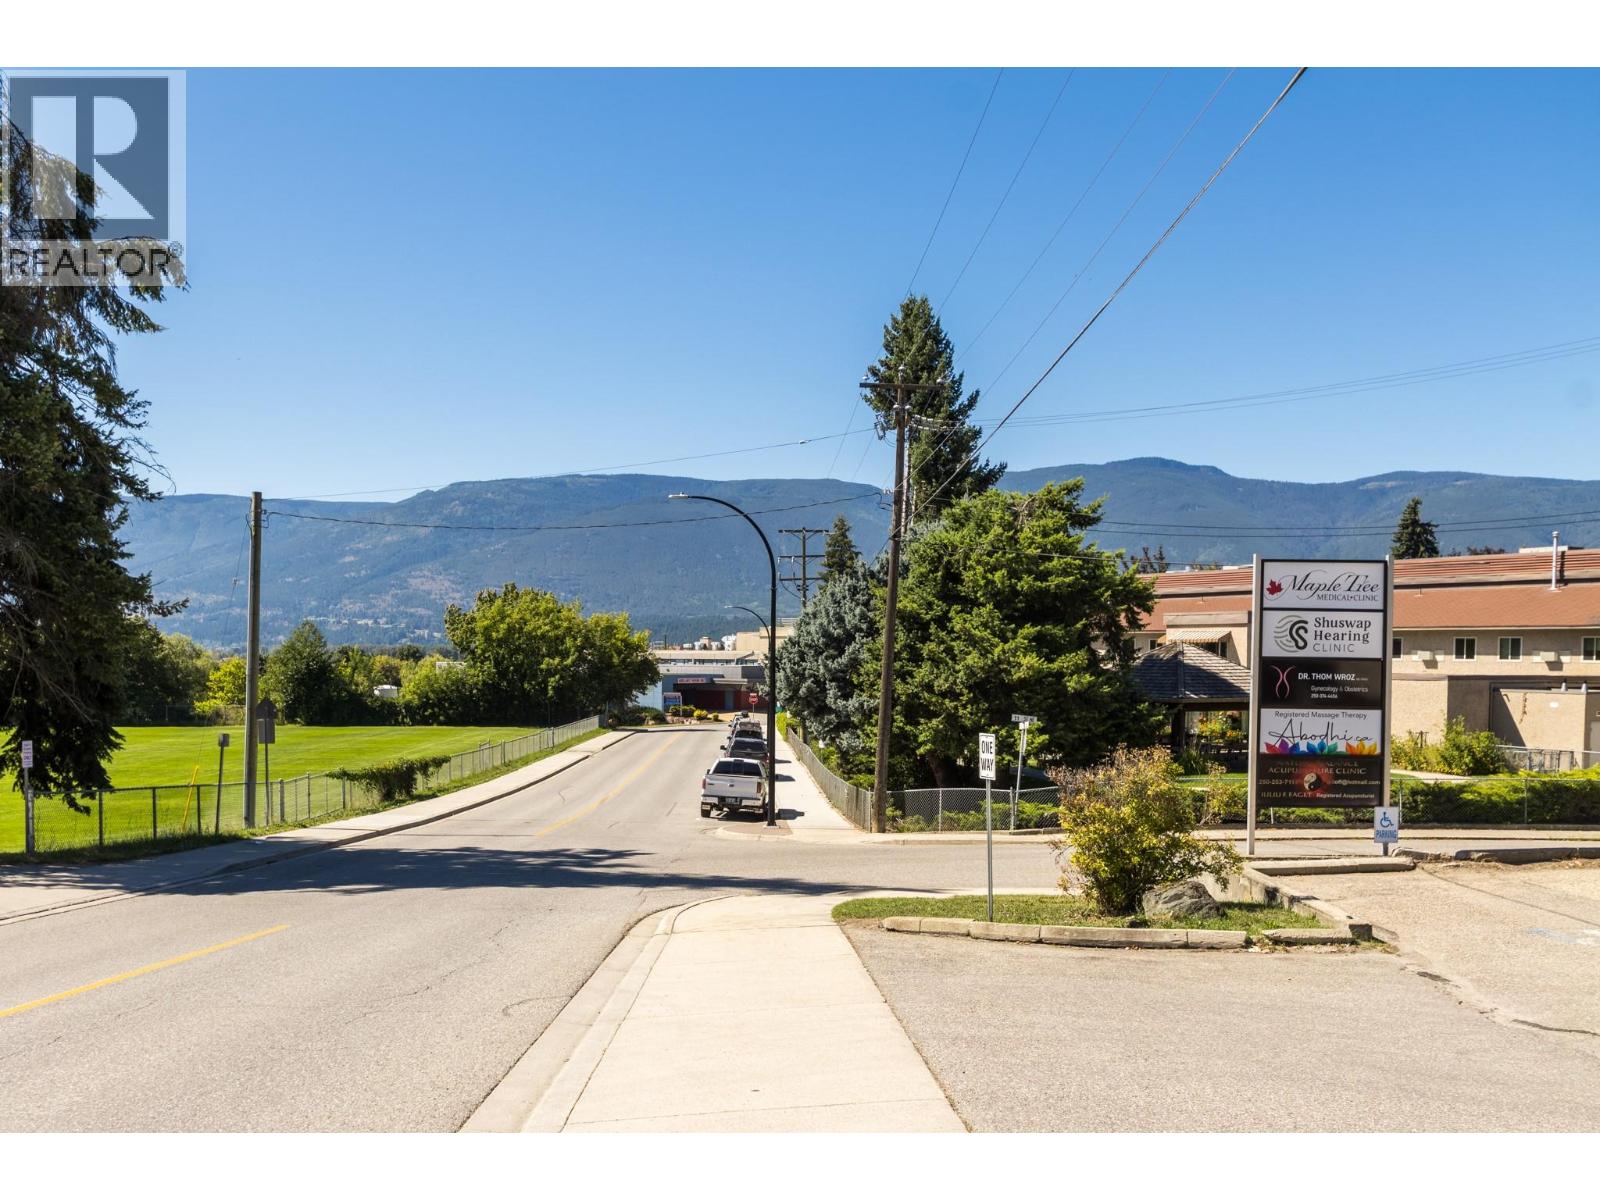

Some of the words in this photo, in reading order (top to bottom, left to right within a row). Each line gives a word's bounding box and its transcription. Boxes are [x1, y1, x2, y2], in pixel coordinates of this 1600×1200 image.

[1279, 570, 1341, 600] Maple
[1344, 572, 1380, 592] Tree
[1313, 616, 1372, 631] Shuswap
[1313, 630, 1370, 644] Hearing
[1312, 643, 1355, 653] CLINIC
[1298, 672, 1310, 680] DR.
[1334, 673, 1356, 681] WROZ
[1310, 685, 1339, 693] Gynecology
[1274, 710, 1310, 719] Registered
[1311, 711, 1340, 720] Massage
[1341, 711, 1368, 721] Therapy
[981, 740, 993, 755] ONE
[980, 757, 994, 772] WAY
[1375, 829, 1398, 839] PARKING
